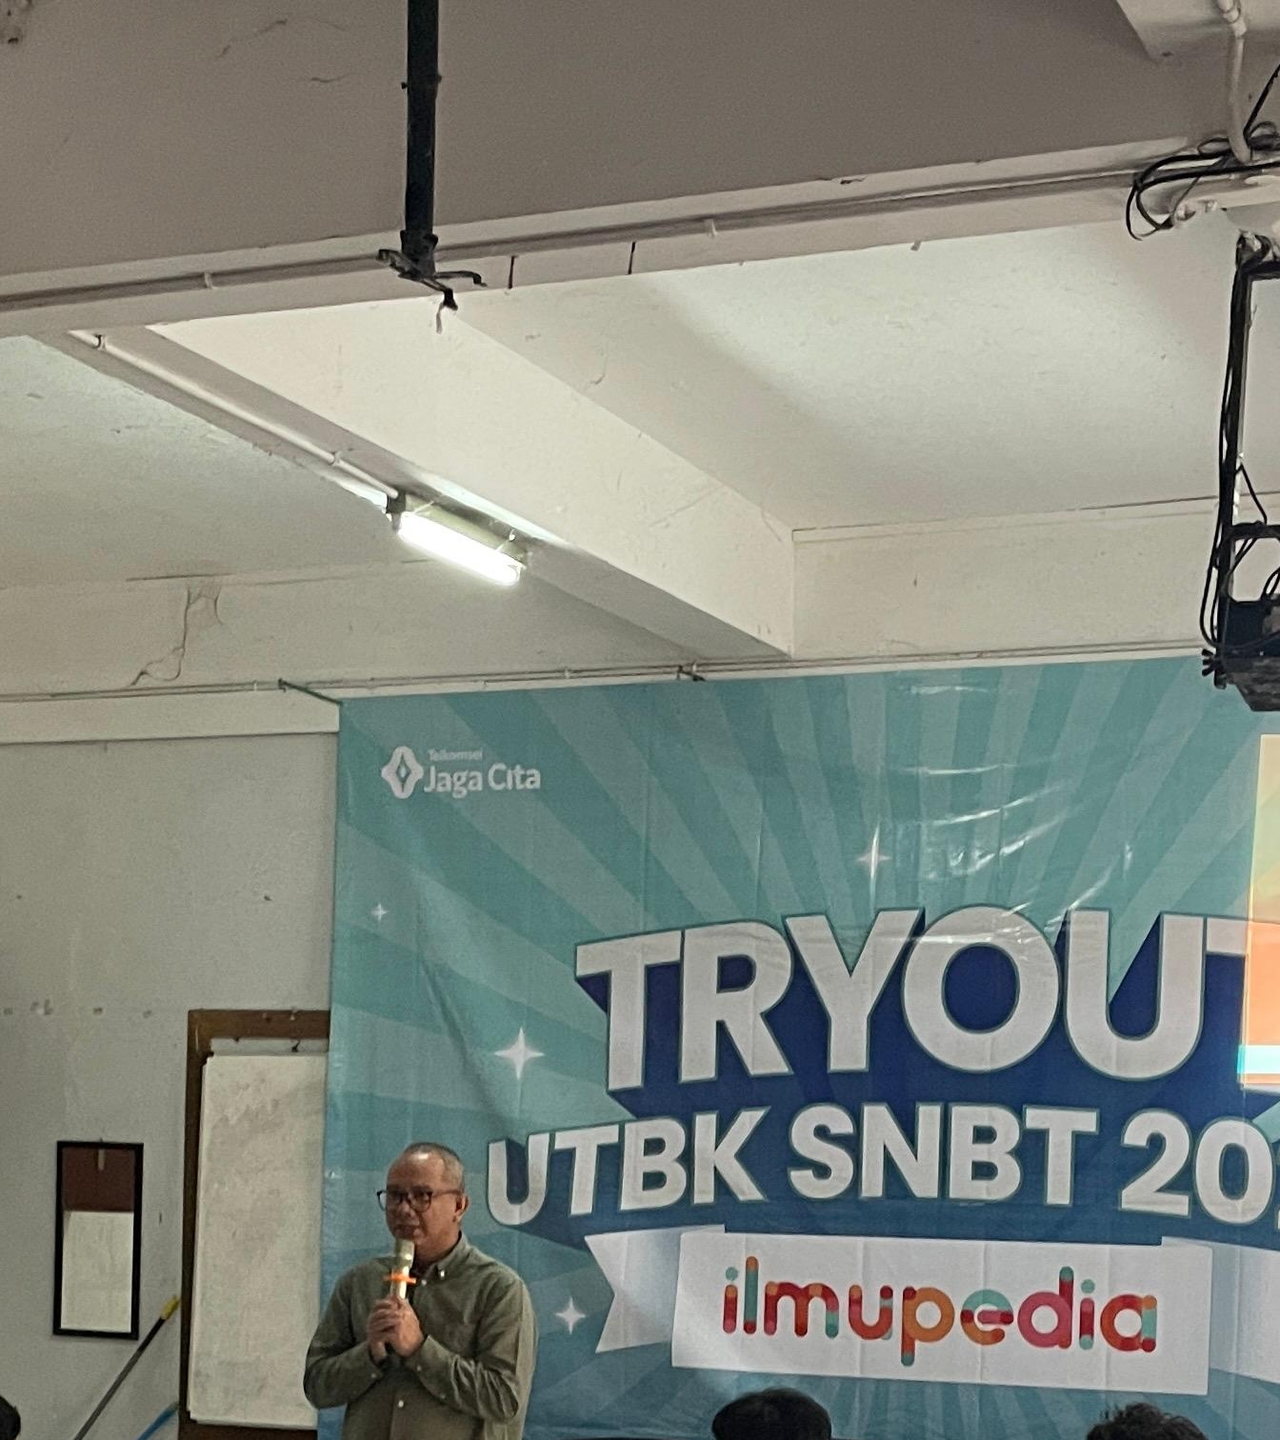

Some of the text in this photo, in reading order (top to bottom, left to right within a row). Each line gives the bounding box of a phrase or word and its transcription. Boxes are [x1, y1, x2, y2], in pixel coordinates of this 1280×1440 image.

[423, 762, 541, 799] Jaga Cita
[486, 1105, 770, 1227] UTBK
[787, 1102, 1099, 1207] SNBT
[722, 1255, 1158, 1366] ilmupedia
